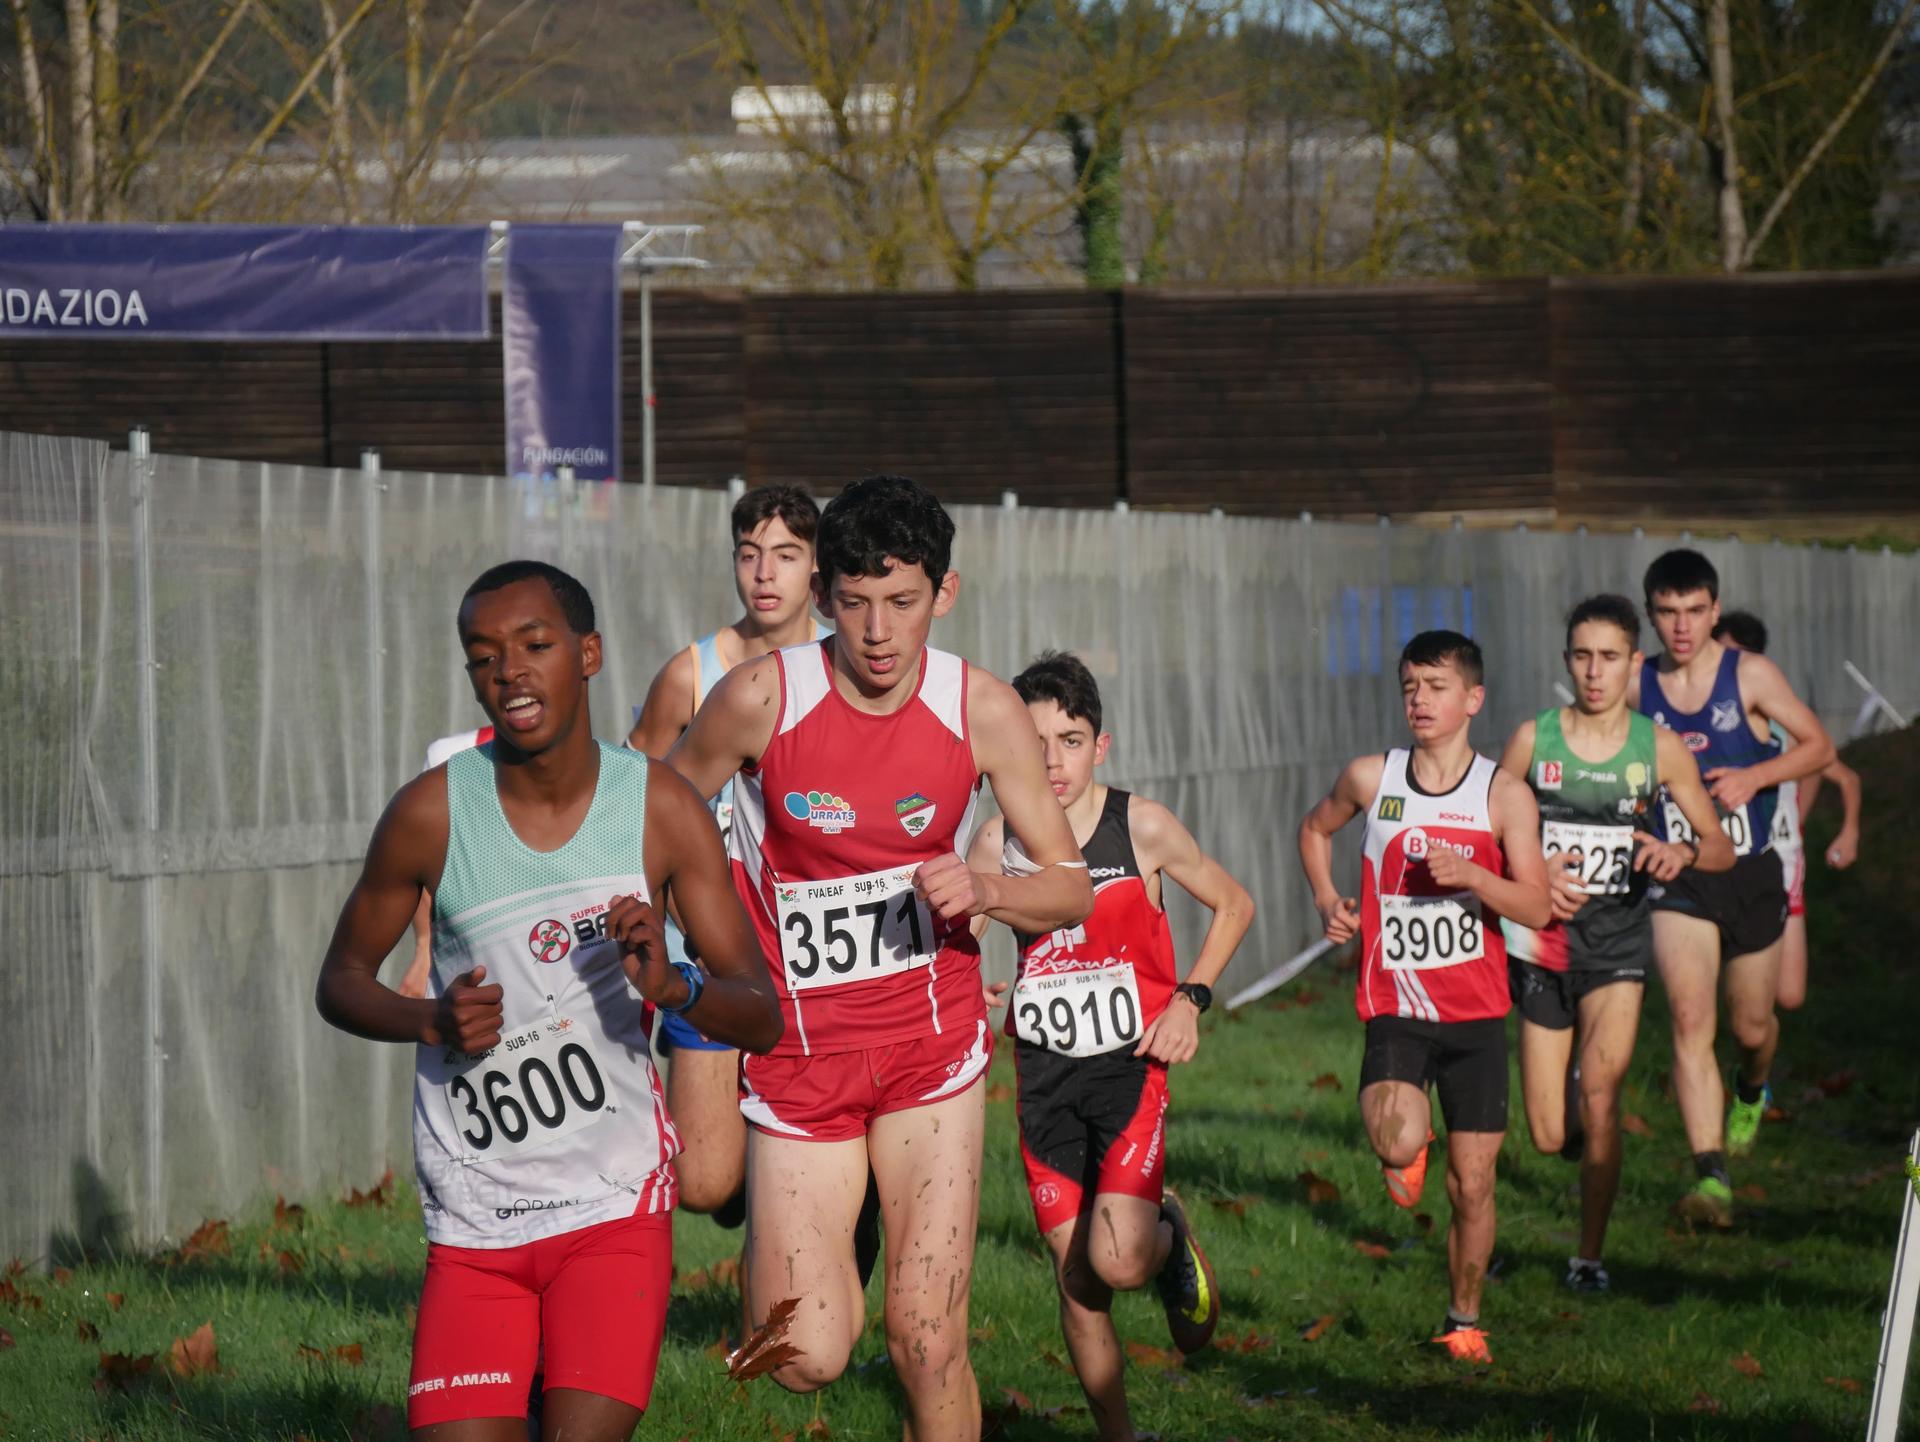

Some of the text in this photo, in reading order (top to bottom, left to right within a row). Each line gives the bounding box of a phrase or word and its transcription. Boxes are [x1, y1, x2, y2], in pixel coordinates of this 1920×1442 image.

[0, 288, 149, 326] DAZIOA
[811, 811, 855, 821] URRATS
[808, 885, 844, 899] FVA/EAF
[854, 878, 886, 893] SUB-16
[570, 904, 605, 921] SUPER
[784, 891, 924, 979] 3571
[1385, 910, 1478, 961] 3908
[1019, 986, 1137, 1051] 3910
[505, 1031, 540, 1051] SUB-16
[450, 1043, 605, 1150] 3600
[408, 1372, 511, 1397] SUPER AMARA
